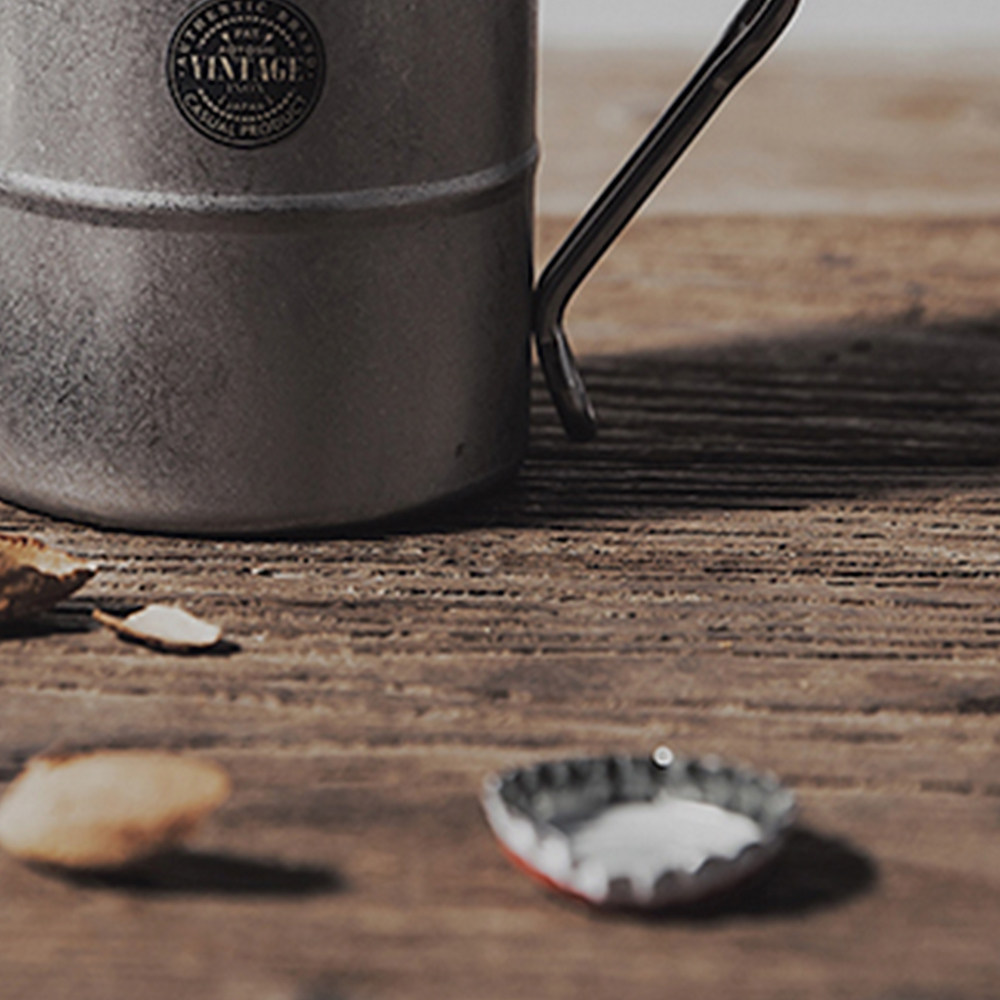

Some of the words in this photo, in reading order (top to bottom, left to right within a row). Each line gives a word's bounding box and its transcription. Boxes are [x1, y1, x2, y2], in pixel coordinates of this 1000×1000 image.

[176, 1, 268, 66] AUTHENTIC
[190, 55, 304, 81] VINTAGE
[183, 92, 236, 137] CASUAL
[238, 96, 307, 137] PRODUCT
